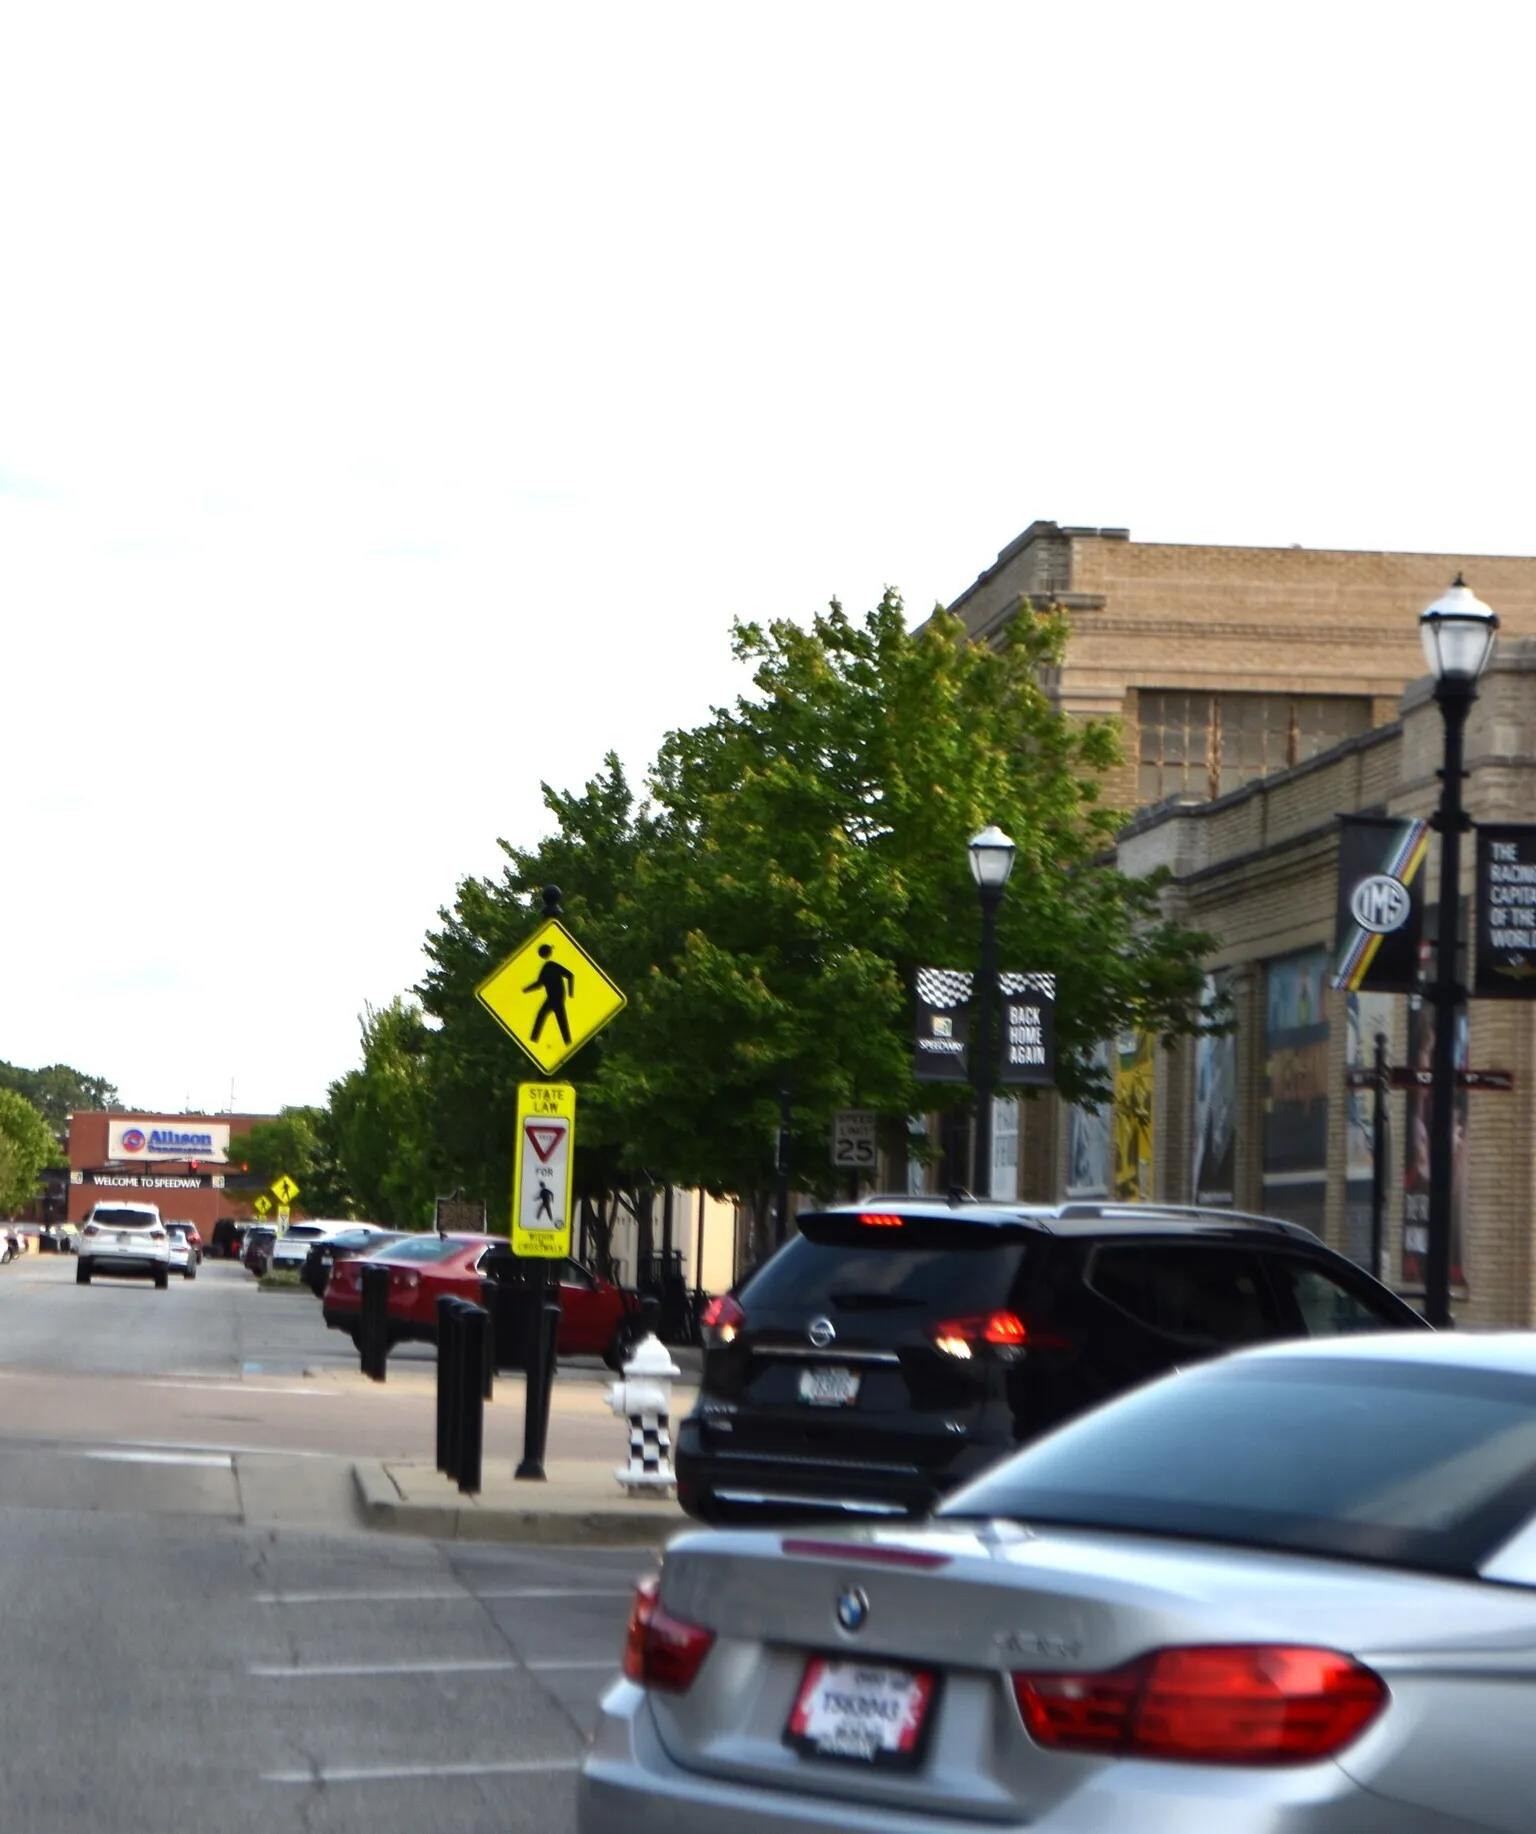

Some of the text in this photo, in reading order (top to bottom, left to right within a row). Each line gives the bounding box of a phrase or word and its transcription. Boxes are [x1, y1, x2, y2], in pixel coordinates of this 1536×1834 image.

[1490, 842, 1518, 861] THE
[1360, 883, 1402, 925] IMS
[1490, 907, 1536, 927] OF THE
[1009, 1004, 1041, 1026] BACK
[1009, 1026, 1043, 1045] HOME
[1009, 1046, 1046, 1065] AGAIN
[528, 1088, 565, 1101] STATE
[533, 1101, 559, 1113] LAW
[148, 1130, 212, 1146] Allison
[840, 1127, 871, 1137] LIMIT
[837, 1138, 874, 1162] 25
[535, 1167, 554, 1178] FOR
[94, 1176, 202, 1189] WELCOME TO SPEEDWAY
[518, 1243, 564, 1253] CROSSWALK
